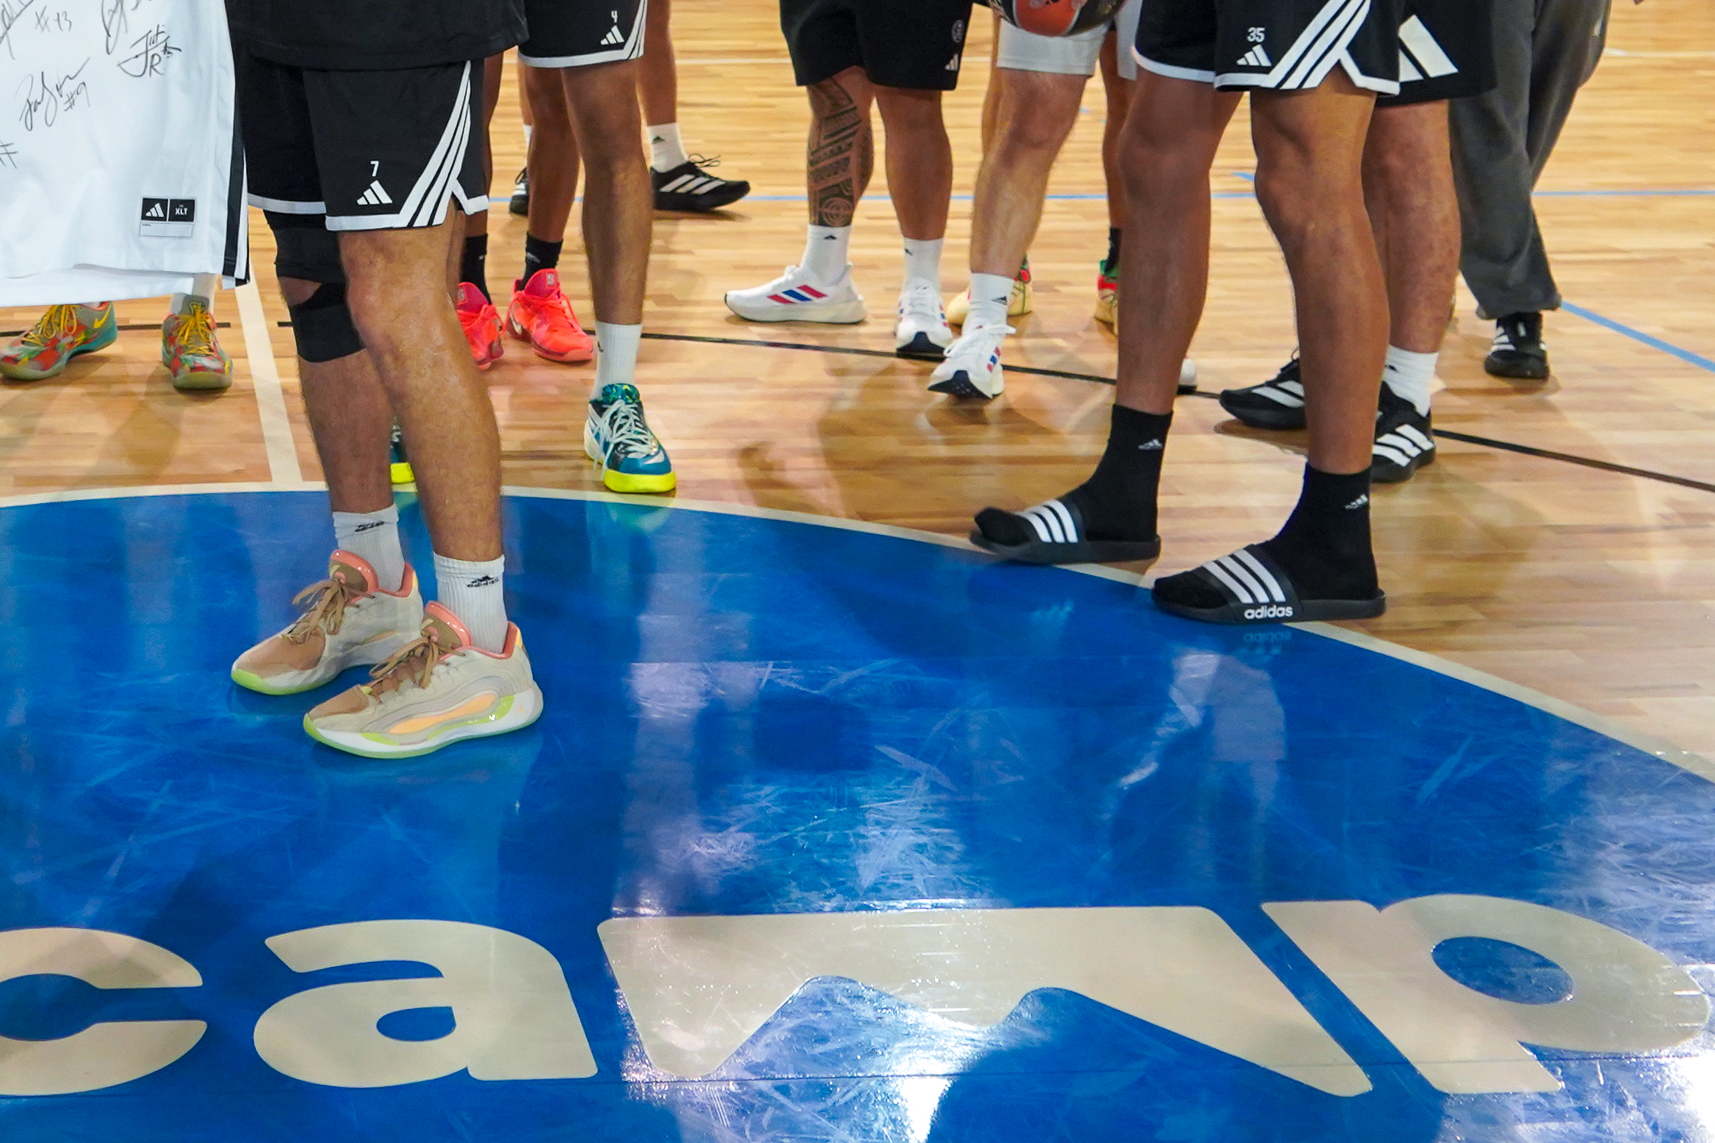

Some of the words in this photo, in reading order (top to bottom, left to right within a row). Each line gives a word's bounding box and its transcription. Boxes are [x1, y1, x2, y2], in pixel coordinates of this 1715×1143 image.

[611, 10, 619, 23] 4
[1247, 26, 1265, 43] 35
[370, 160, 380, 177] 7
[175, 207, 189, 216] XLT
[1244, 604, 1294, 620] adidas
